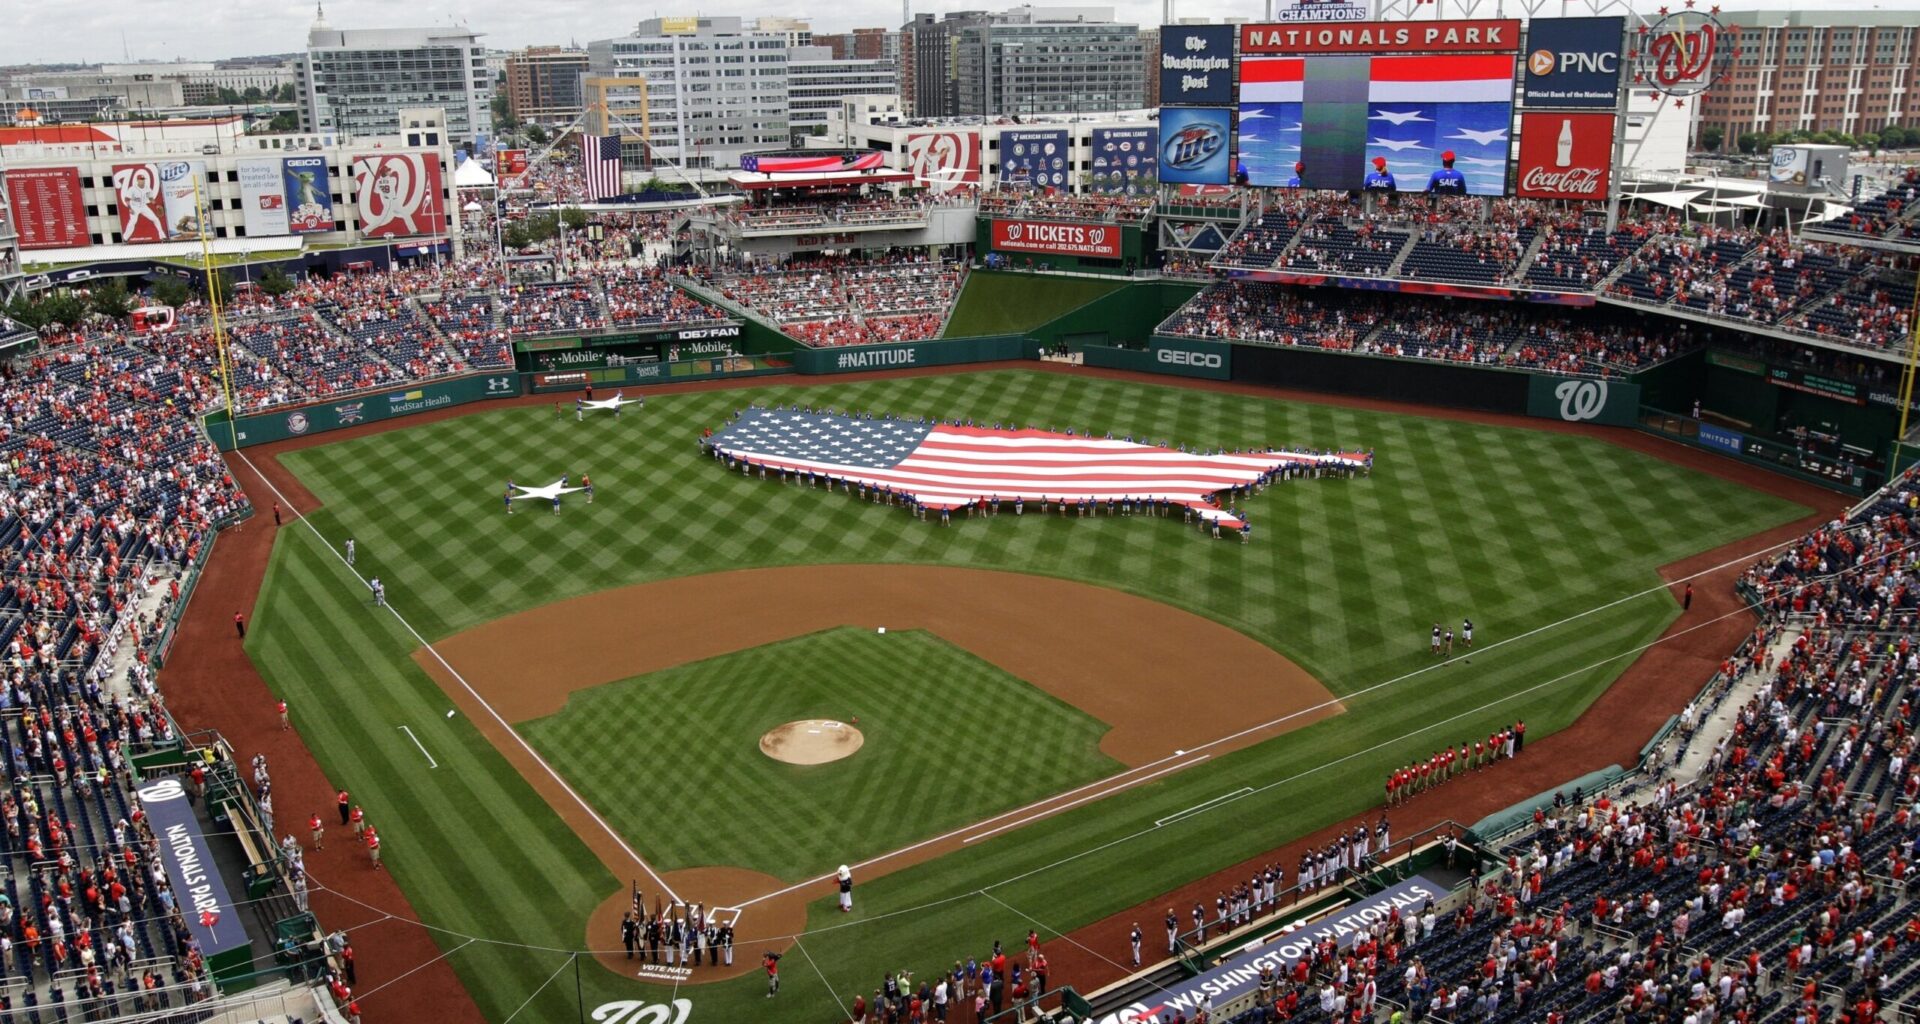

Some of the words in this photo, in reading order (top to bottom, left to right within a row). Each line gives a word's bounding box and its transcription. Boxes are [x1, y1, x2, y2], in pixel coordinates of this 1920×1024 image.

[1280, 8, 1366, 20] CHAMPIONS
[1185, 36, 1207, 52] The
[1250, 28, 1409, 46] NATIONALS
[1425, 27, 1501, 44] PARK
[1162, 52, 1230, 72] Washington
[1558, 52, 1617, 73] PNC
[1182, 75, 1208, 92] Post
[1522, 166, 1604, 194] Coca-Cola
[797, 236, 817, 246] RED
[1026, 224, 1084, 242] TICKETS
[1000, 240, 1038, 249] nationals.com
[711, 328, 739, 337] FAN
[692, 341, 727, 354] Mobile
[562, 352, 598, 364] Mobile
[838, 348, 915, 368] #NATITUDE
[1158, 349, 1222, 368] GEICO
[390, 400, 423, 414] MedStar
[425, 395, 450, 406] Health
[1700, 432, 1730, 445] UNITED
[165, 823, 207, 886] NATIONALS
[1164, 936, 1312, 1011] WASHINGTON
[1314, 885, 1428, 938] NATIONALS
[638, 972, 687, 980] nationals.com
[642, 964, 667, 972] VOTE
[667, 967, 693, 975] NATS
